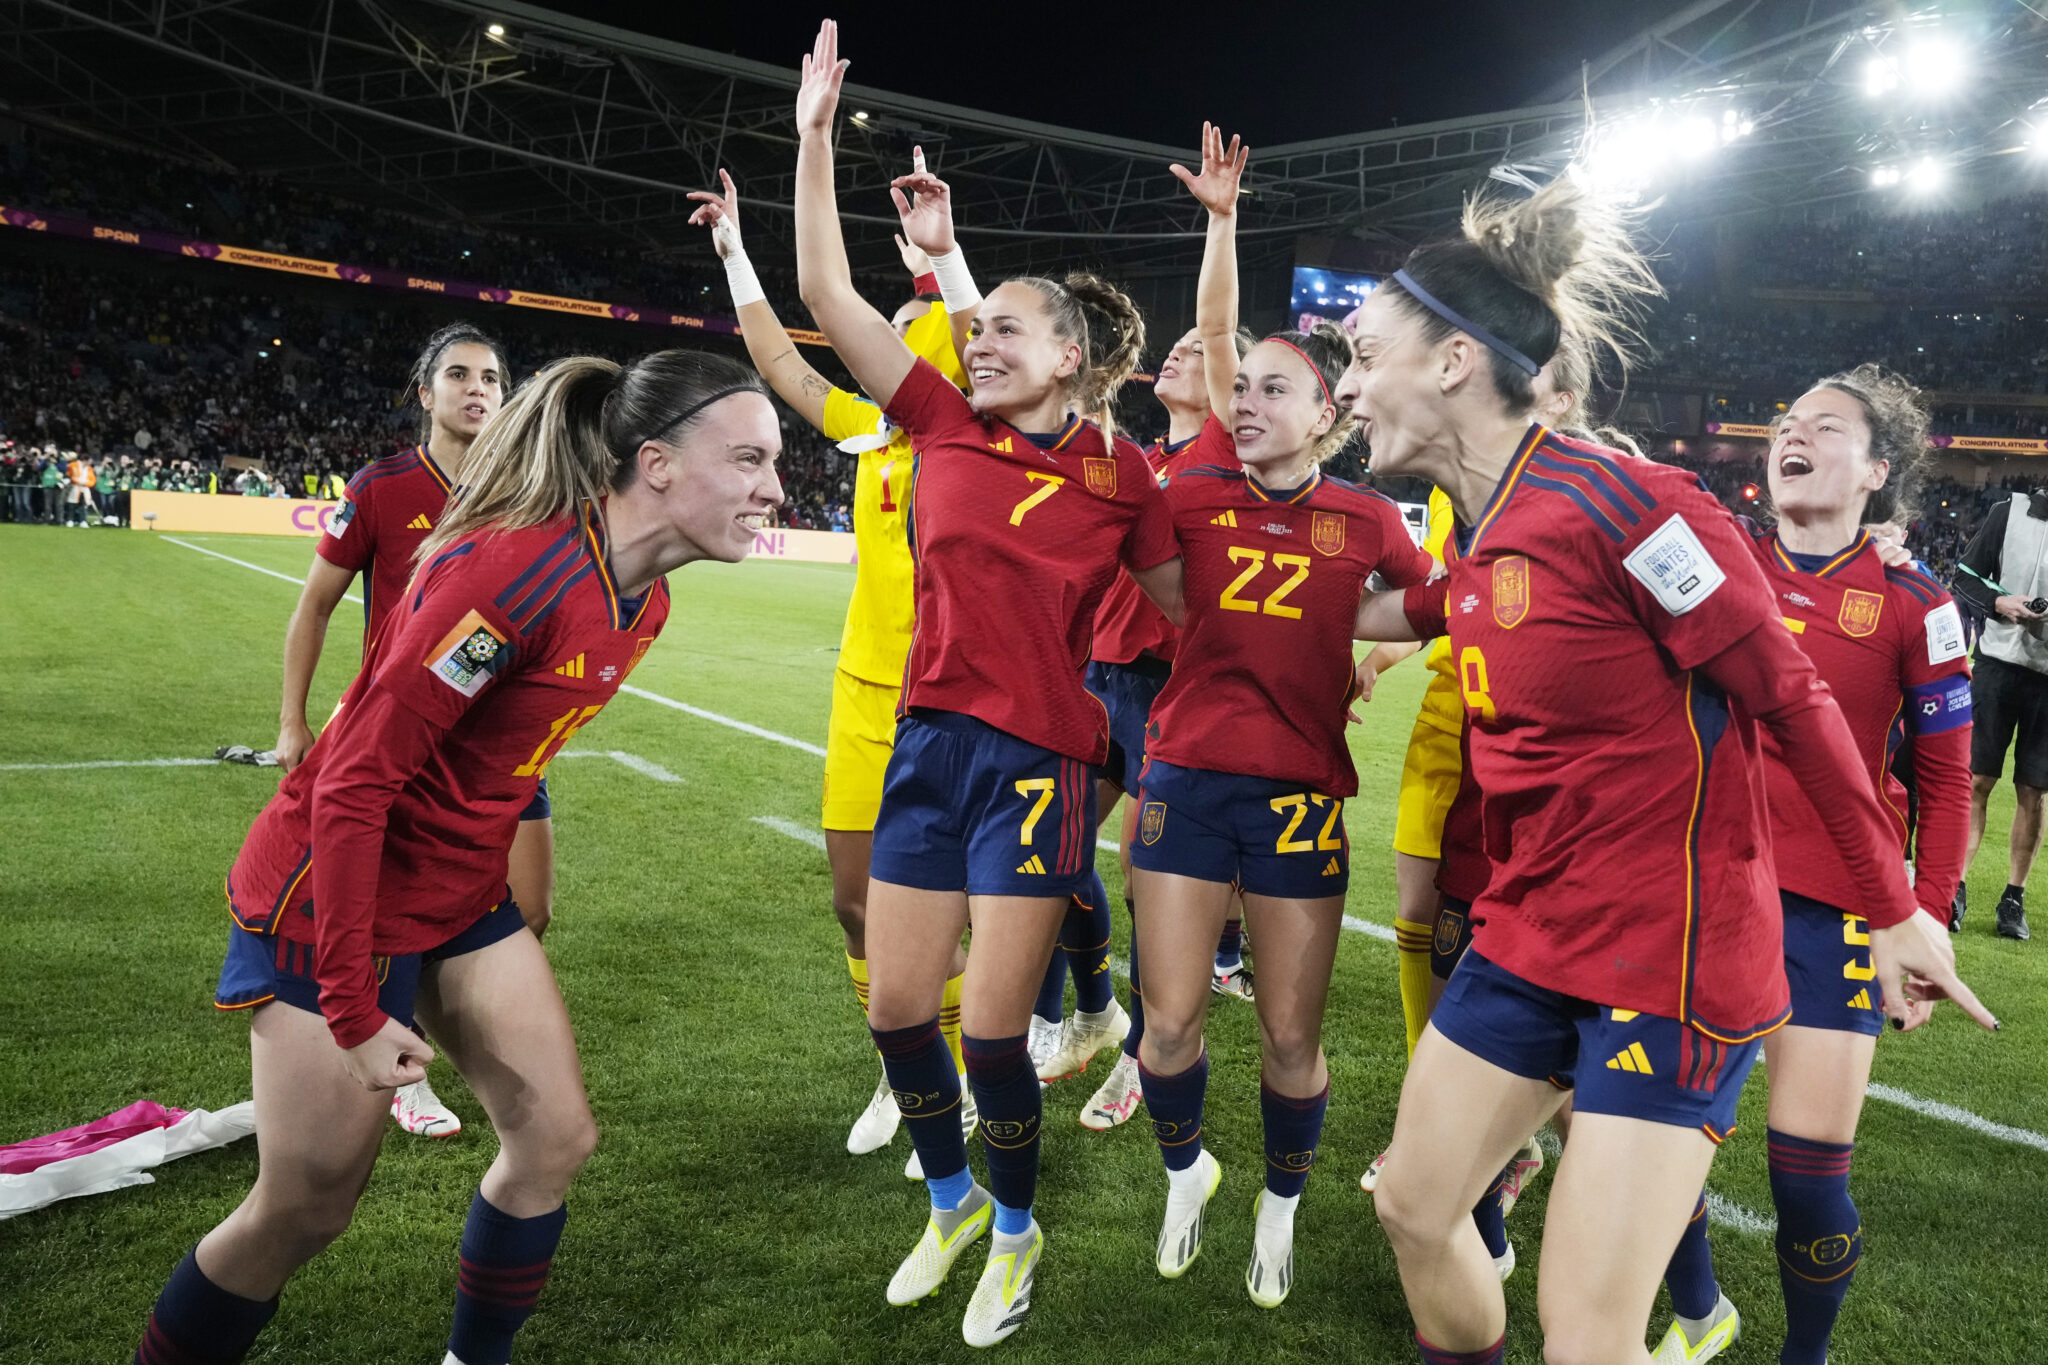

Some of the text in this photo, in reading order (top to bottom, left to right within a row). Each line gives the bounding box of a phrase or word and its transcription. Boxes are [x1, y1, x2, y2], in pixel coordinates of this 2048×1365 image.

[93, 226, 140, 244] SPAIN
[229, 250, 328, 274] CONGRATULATIONS
[407, 277, 446, 292] SPAIN
[518, 295, 603, 313] CONGRATULATIONS
[670, 315, 704, 328] SPAIN
[1959, 439, 2039, 450] CONGRATULATIONS
[881, 460, 897, 513] 1
[1009, 471, 1066, 527] 7
[1643, 537, 1680, 567] FOOTBALL
[1651, 545, 1689, 578] UNITES
[1220, 546, 1311, 619] 22
[1460, 646, 1496, 723] 9
[1015, 778, 1055, 845] 7
[1270, 792, 1342, 853] 22
